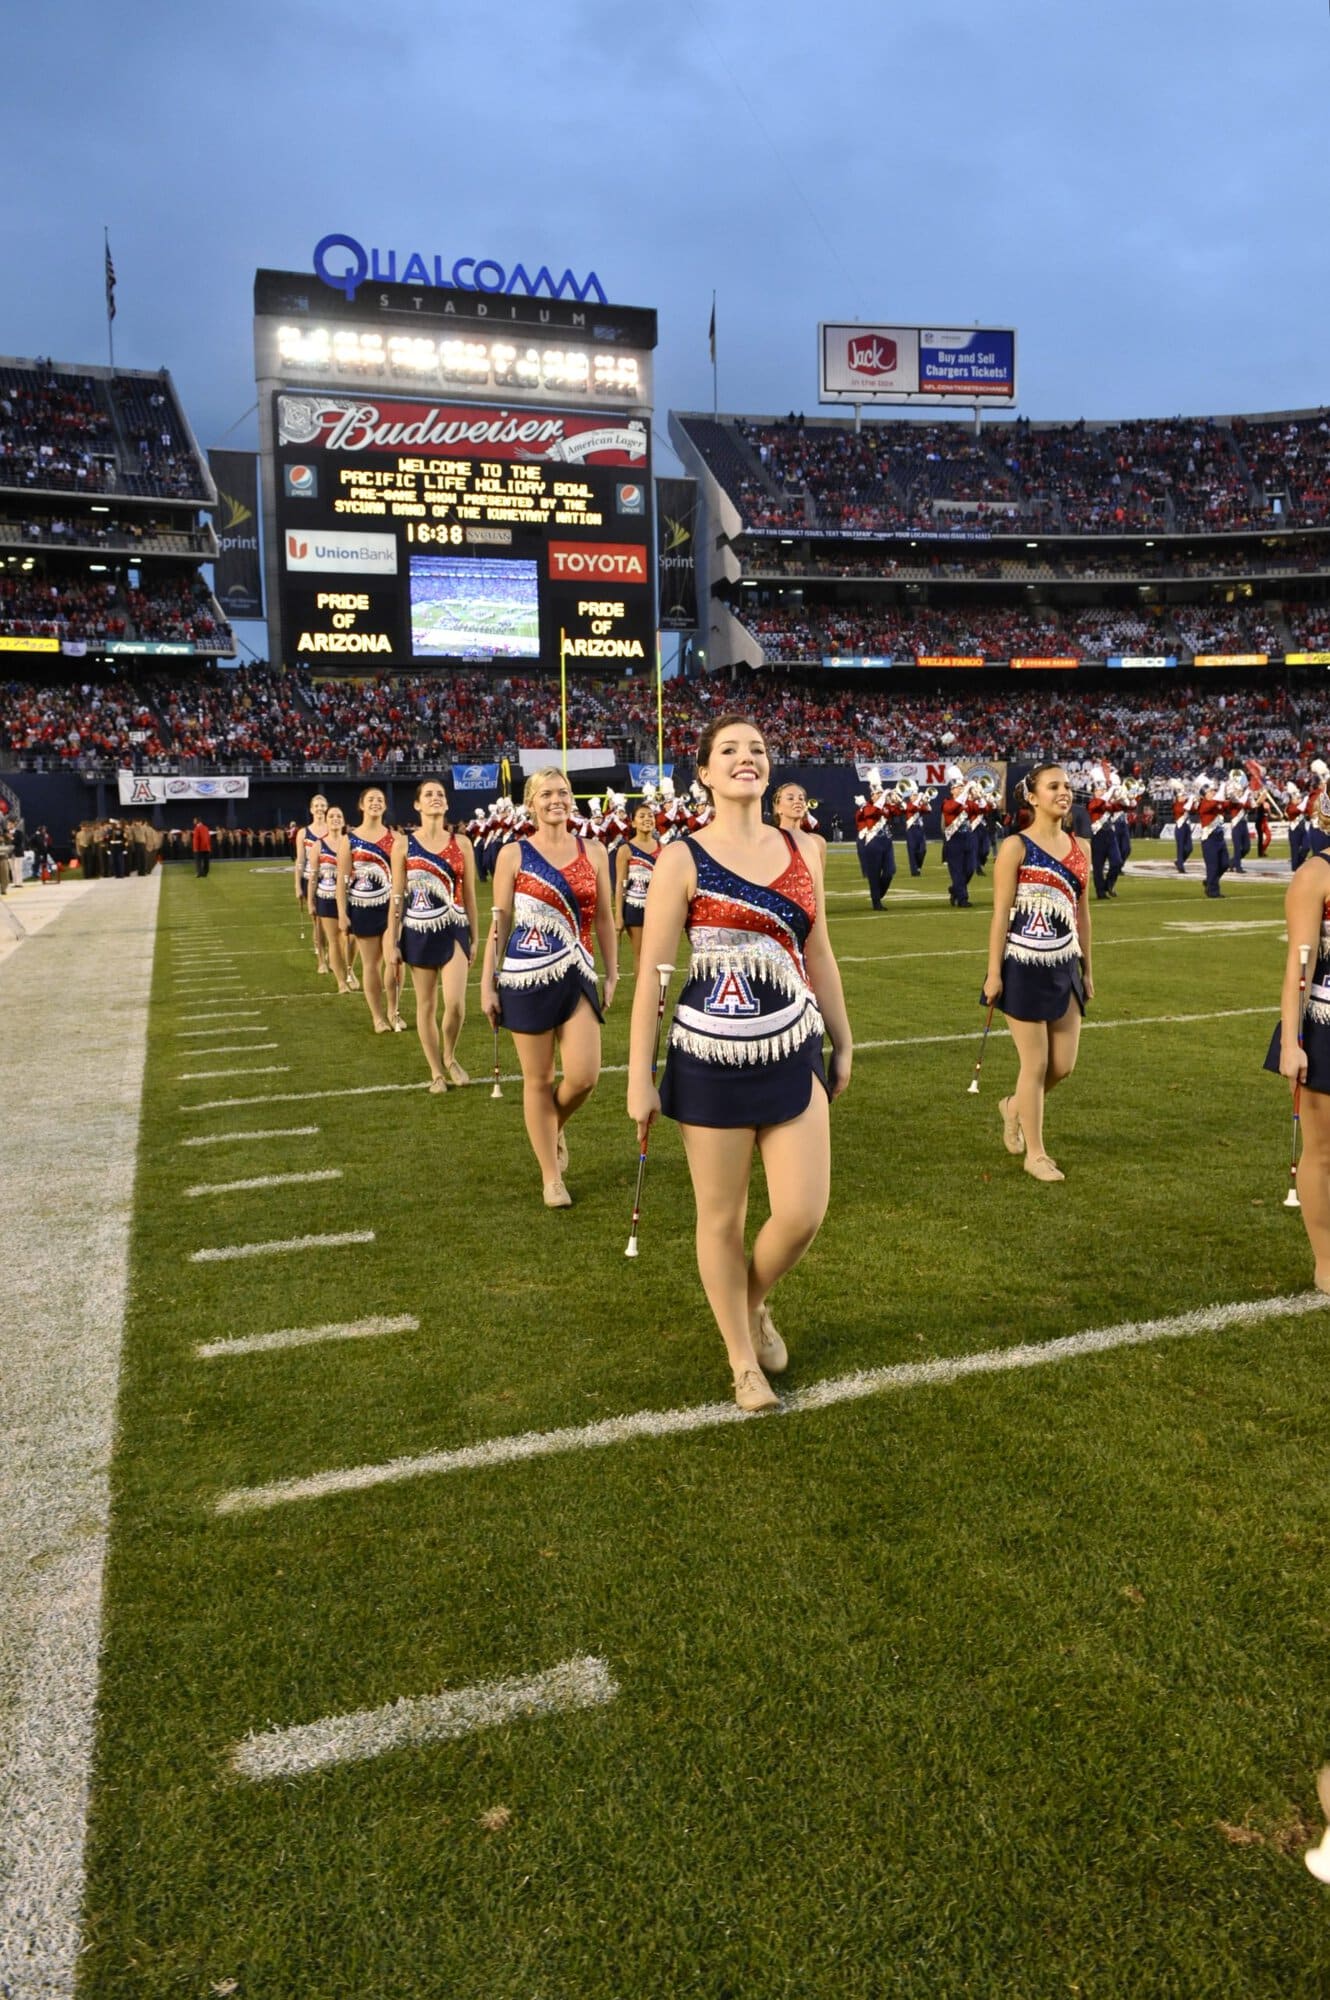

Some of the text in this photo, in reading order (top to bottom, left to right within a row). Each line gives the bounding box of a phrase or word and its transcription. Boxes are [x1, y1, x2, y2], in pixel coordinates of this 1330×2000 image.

[313, 233, 608, 304] QUALCOMM
[380, 294, 585, 326] STADIUM
[850, 339, 896, 370] Jack
[938, 351, 995, 365] Buy and Sell
[926, 364, 1007, 379] Chargers Tickets!
[313, 406, 564, 450] Budweiser
[568, 435, 645, 456] American Lager
[398, 458, 541, 480] WELCOME TO THE
[340, 470, 594, 498] PACIFIC LIFE HOLIDAY BOWL
[350, 487, 587, 511] PRE-GAME SHOW PRESENTED BY THE
[335, 500, 386, 514] SYCUAN
[392, 502, 426, 516] BAND
[432, 505, 449, 517] OF
[456, 506, 480, 519] THE
[556, 511, 602, 525] NATION
[215, 534, 257, 552] Sprint
[407, 523, 463, 545] 16:38
[315, 544, 394, 562] UnionBank
[553, 553, 643, 574] TOYOTA
[659, 554, 694, 570] Sprint
[317, 593, 370, 611] PRIDE
[578, 601, 625, 618] PRIDE
[332, 613, 356, 629] OF
[591, 620, 613, 635] OF
[298, 633, 393, 653] ARIZONA
[562, 638, 644, 658] ARIZONA
[918, 657, 983, 666] WELLS FARGO
[1121, 656, 1166, 667] GEICO
[1204, 655, 1258, 667] CYMER
[454, 780, 484, 790] PACIFIC
[925, 764, 946, 785] N
[131, 779, 157, 803] A
[411, 887, 434, 911] A
[1021, 908, 1057, 939] A
[516, 922, 552, 953] A
[704, 967, 760, 1016] A
